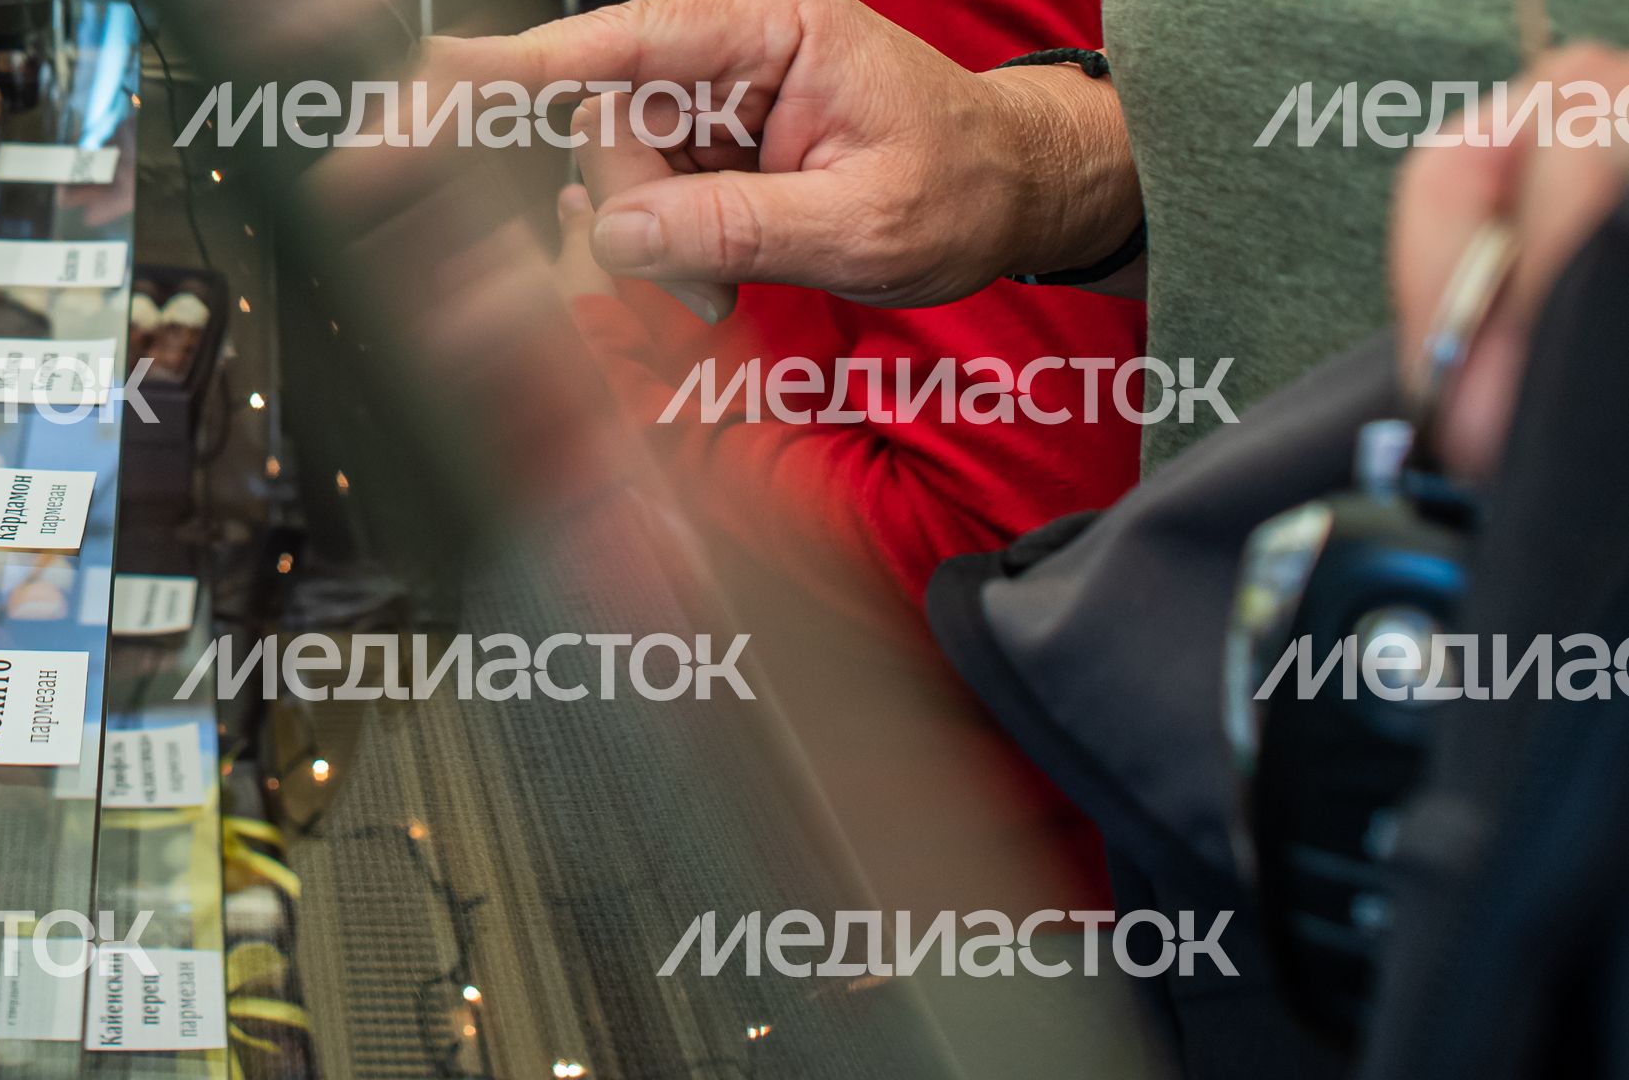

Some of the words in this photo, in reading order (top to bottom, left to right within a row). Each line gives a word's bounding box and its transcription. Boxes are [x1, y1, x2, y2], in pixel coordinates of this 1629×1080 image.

[39, 484, 68, 535] пармезан
[29, 670, 59, 743] пармезан
[98, 952, 124, 1047] Кайенский
[141, 974, 165, 1025] перец
[176, 961, 204, 1037] пармезан
